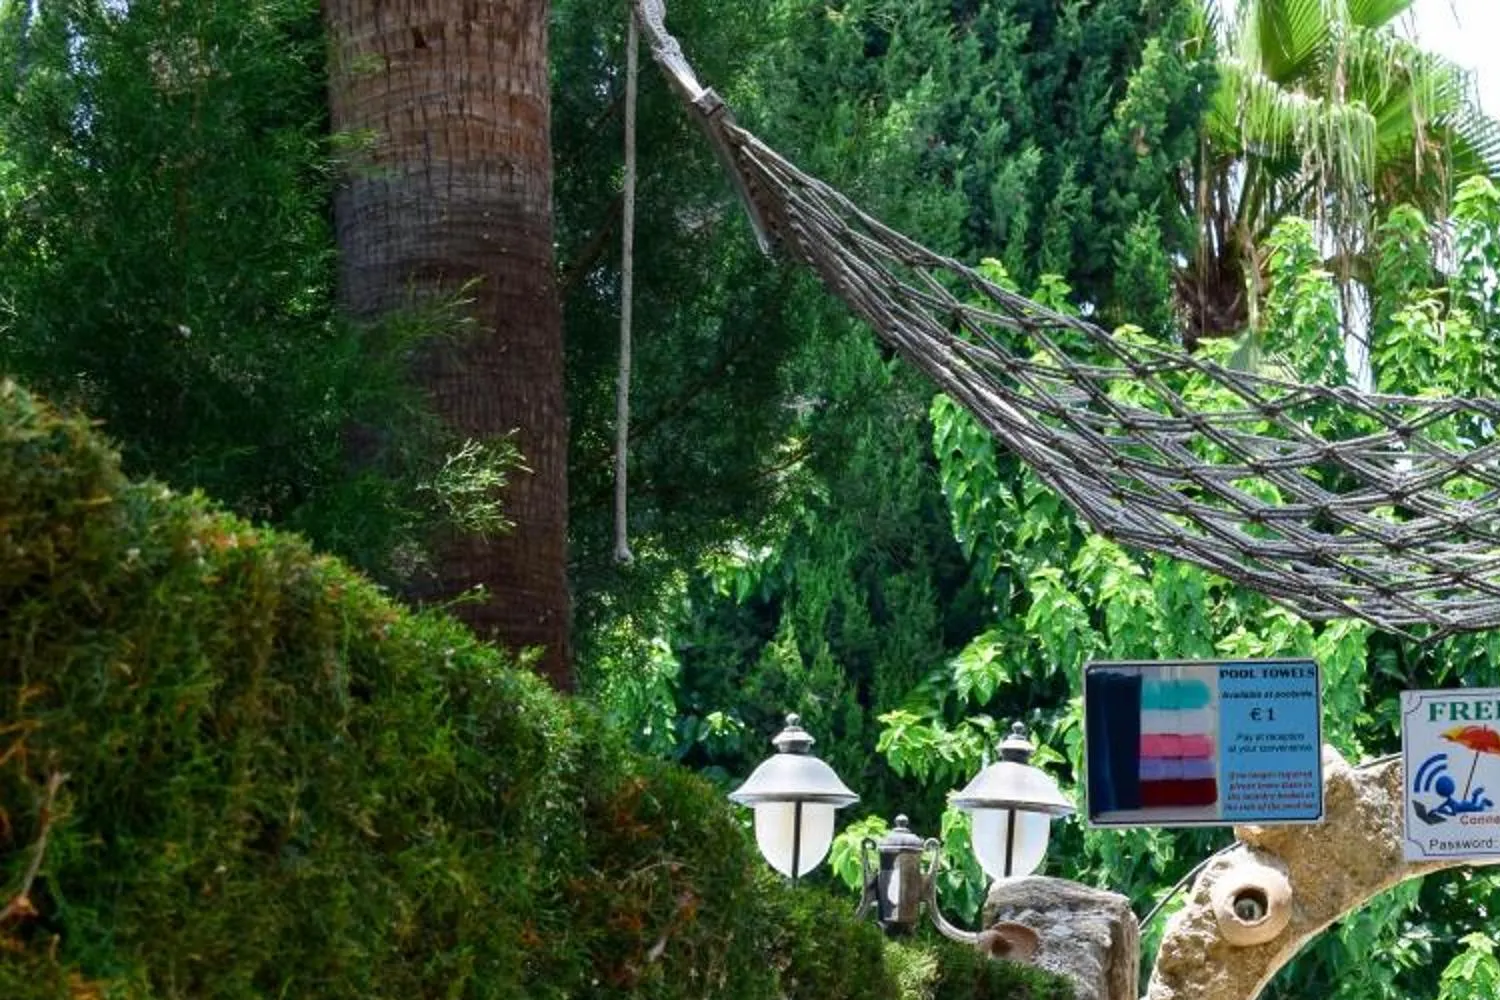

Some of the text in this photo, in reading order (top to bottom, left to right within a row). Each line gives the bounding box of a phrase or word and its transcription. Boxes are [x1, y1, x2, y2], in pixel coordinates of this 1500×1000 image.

[1219, 666, 1315, 679] POOL TOWELS
[1429, 836, 1499, 850] Password:
